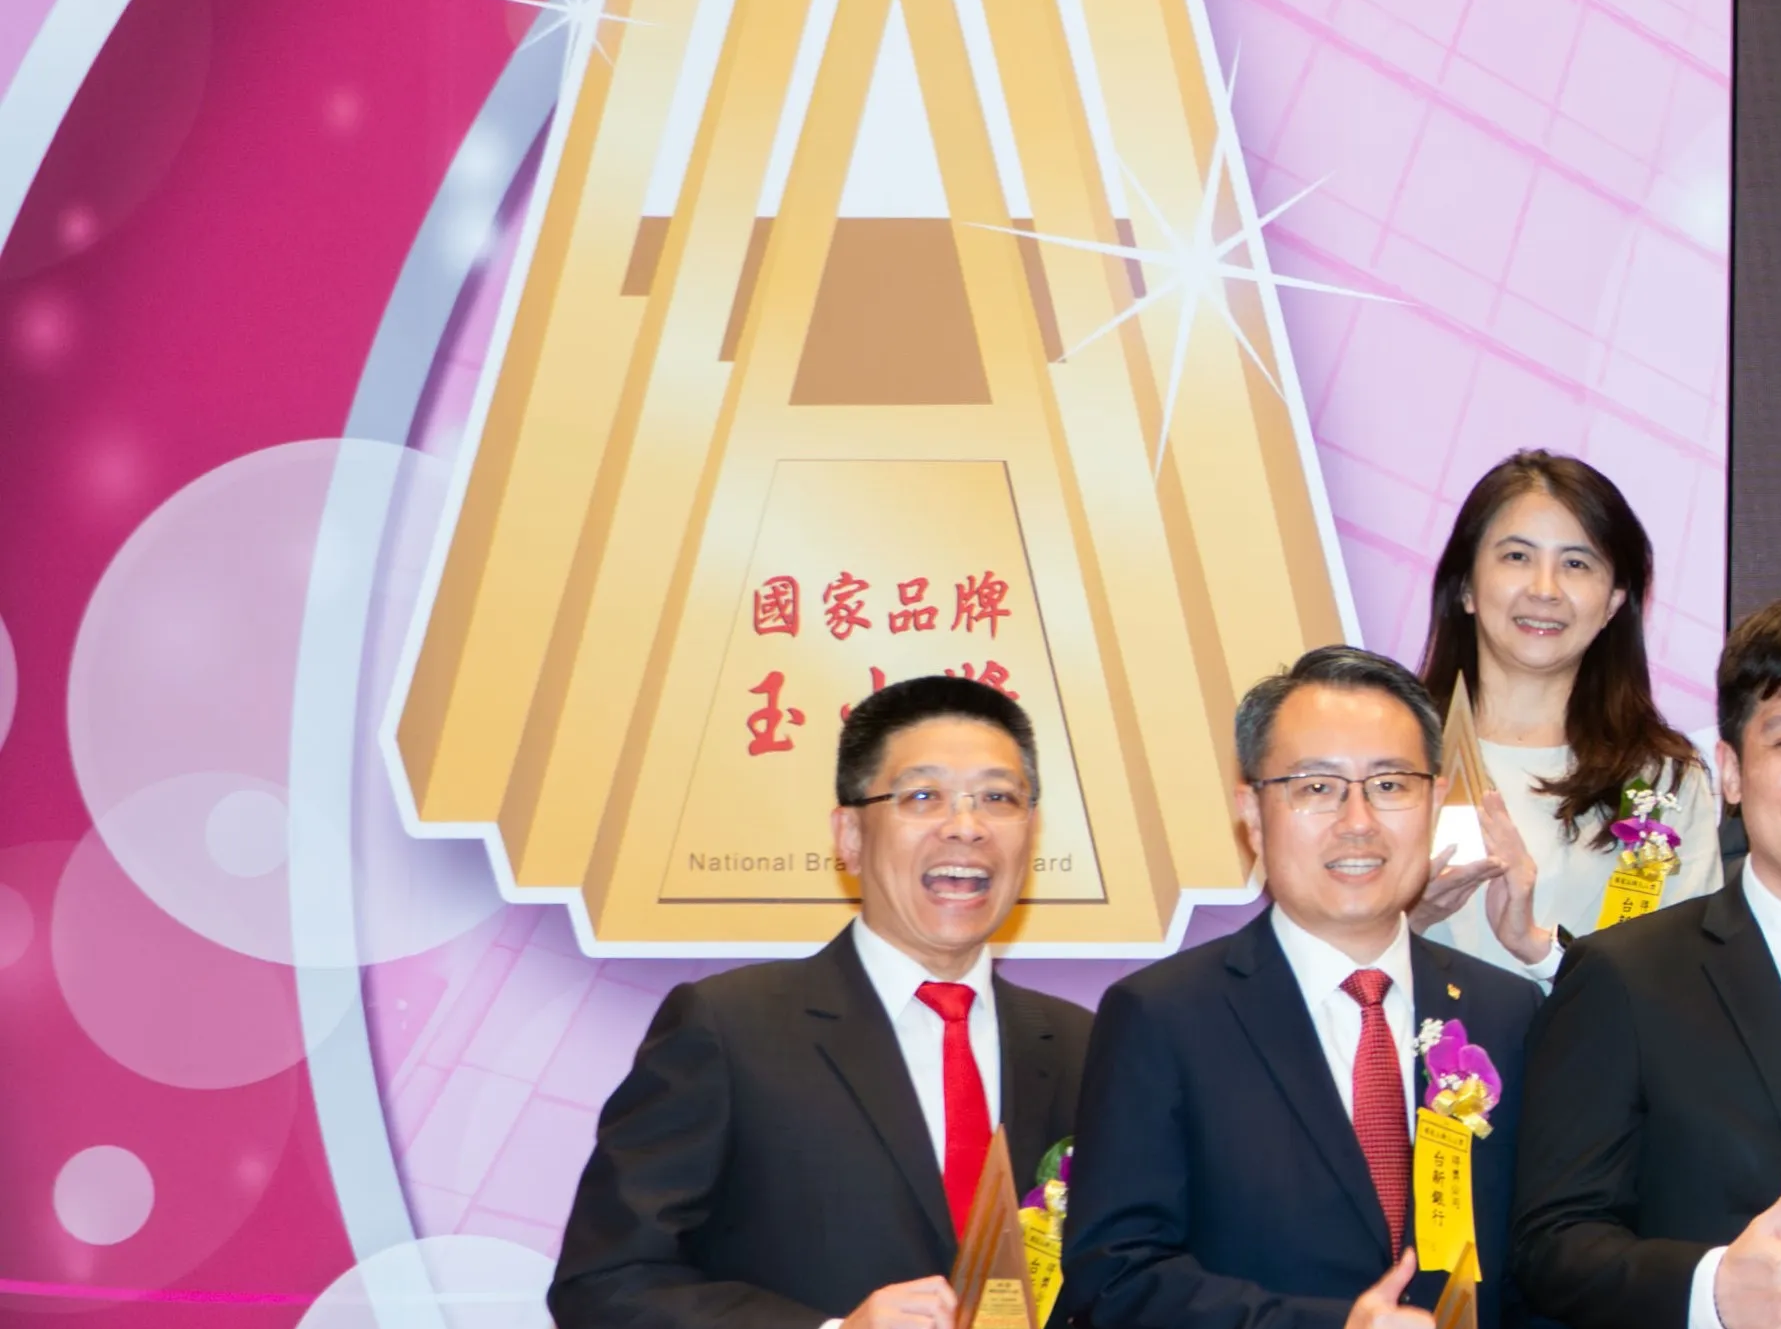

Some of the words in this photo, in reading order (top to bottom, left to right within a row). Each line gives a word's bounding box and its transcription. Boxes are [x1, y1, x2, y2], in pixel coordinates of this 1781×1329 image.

[752, 571, 1013, 641] 國家品牌
[689, 852, 794, 873] National
[806, 852, 848, 873] Bra
[1032, 852, 1073, 873] ard
